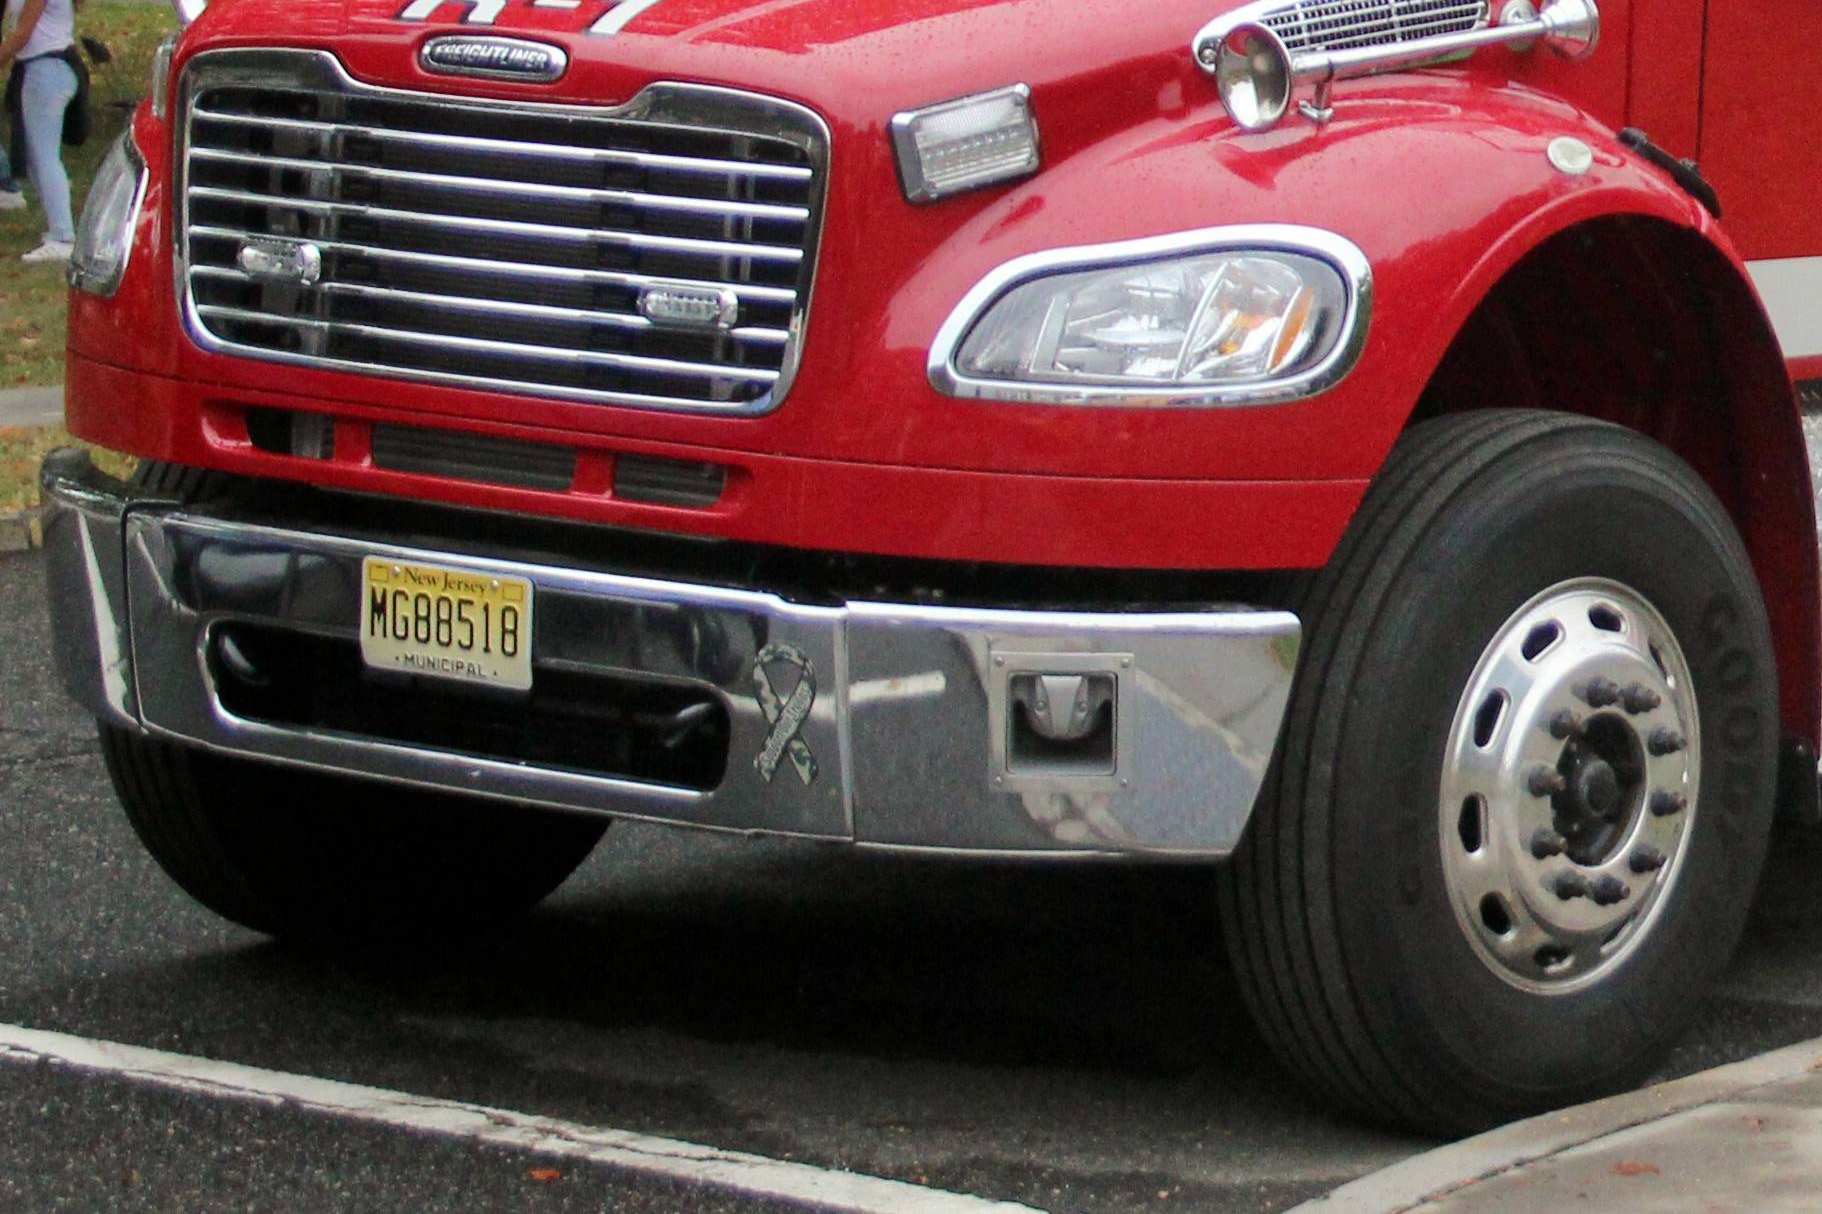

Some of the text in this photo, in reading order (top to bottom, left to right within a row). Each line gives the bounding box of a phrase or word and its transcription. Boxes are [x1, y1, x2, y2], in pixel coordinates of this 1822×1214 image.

[404, 567, 485, 595] New Jersey
[370, 586, 519, 658] MG88518
[404, 652, 488, 678] MUNICIPAL
